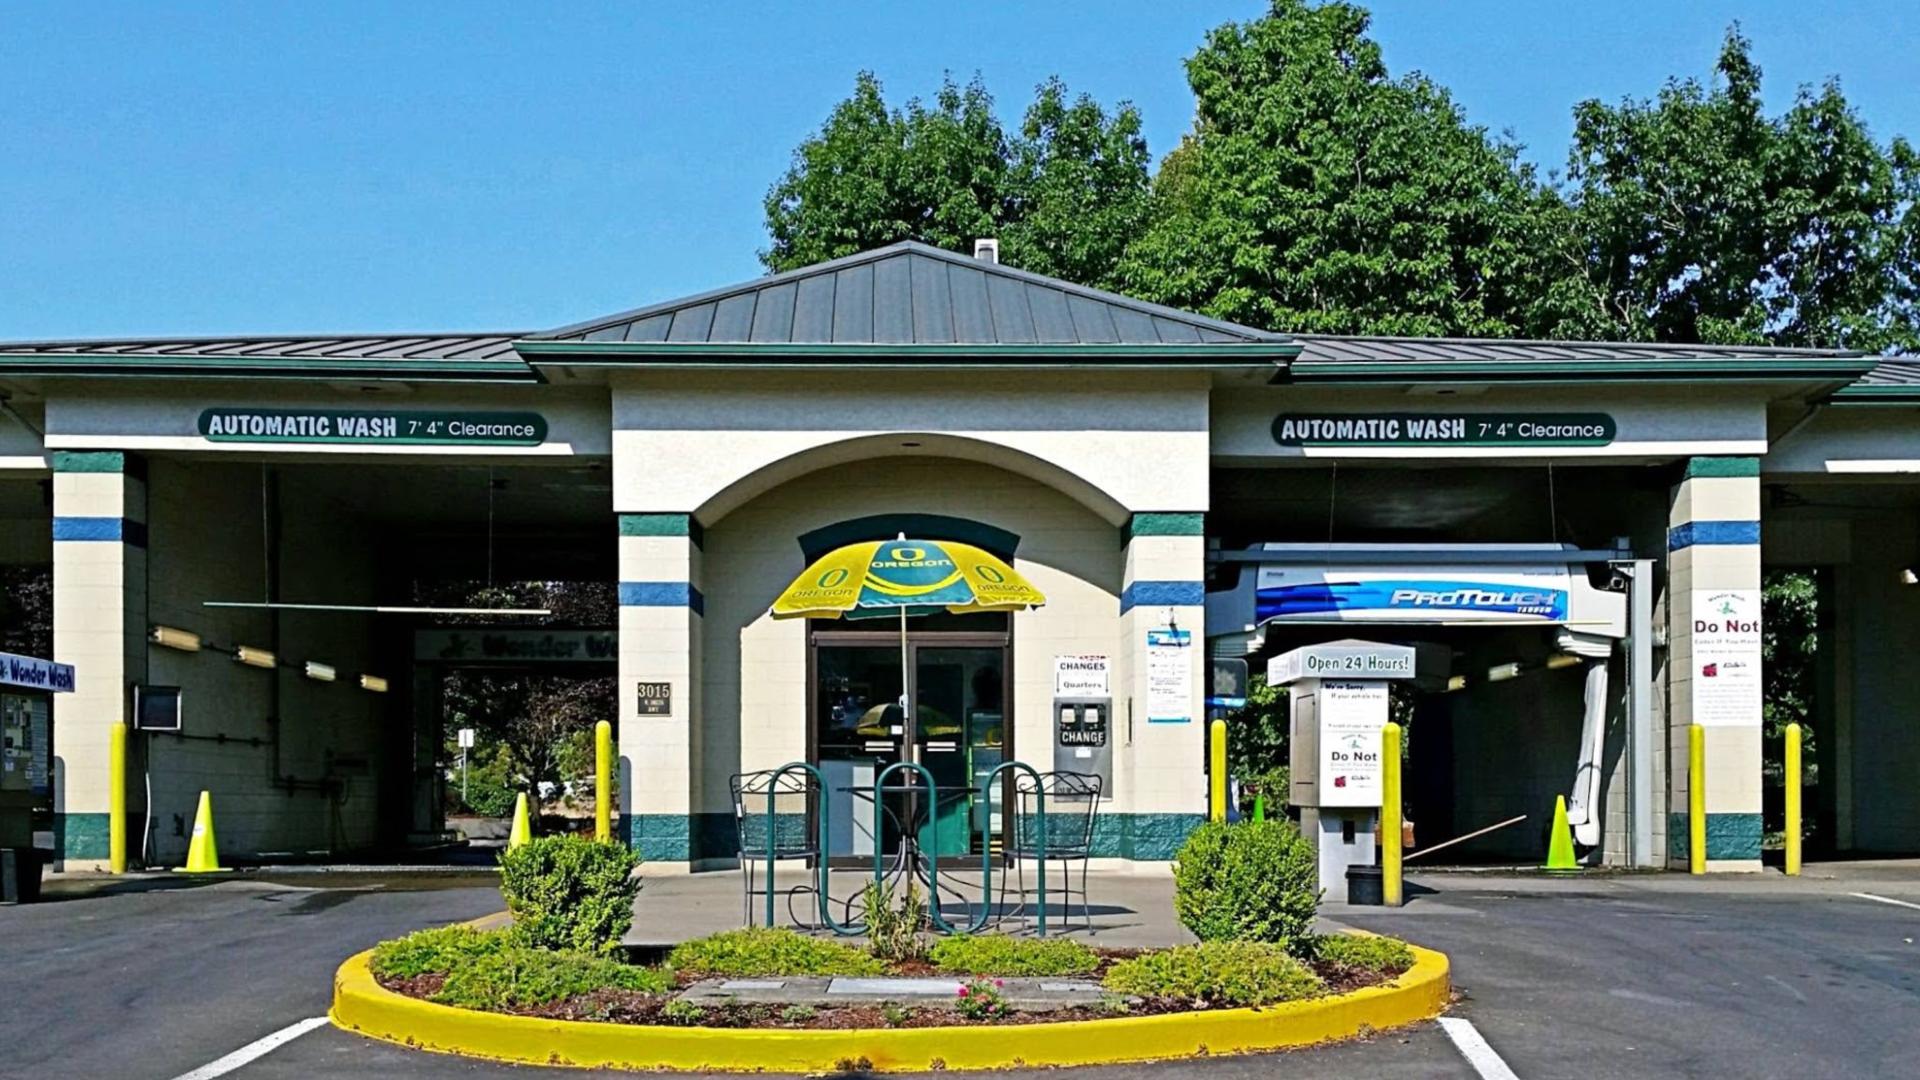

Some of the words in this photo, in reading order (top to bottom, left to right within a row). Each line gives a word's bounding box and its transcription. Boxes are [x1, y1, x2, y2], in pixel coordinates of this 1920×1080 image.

[208, 415, 330, 436] AUTOMATIC
[337, 417, 397, 437] WASH
[408, 421, 422, 435] 7'
[427, 421, 443, 436] 4"
[448, 421, 535, 436] Clearance
[1281, 419, 1400, 440] AUTOMATIC
[1406, 418, 1465, 439] WASH
[1478, 423, 1492, 437] 7'
[1497, 423, 1514, 437] 4"
[1518, 423, 1605, 437] Clearance
[871, 559, 950, 568] OREGON
[1695, 620, 1719, 633] Do
[1726, 620, 1759, 633] Not
[1060, 662, 1106, 671] CHANGES
[1308, 655, 1340, 672] Open
[1345, 657, 1363, 669] 24
[1368, 655, 1409, 670] Hours!
[10, 658, 47, 685] Wonder
[48, 664, 73, 688] Wash
[638, 684, 670, 698] 3015
[1063, 681, 1102, 689] Quarters
[1062, 731, 1104, 743] CHANGE
[1331, 751, 1349, 761] Do
[1353, 751, 1377, 761] Not
